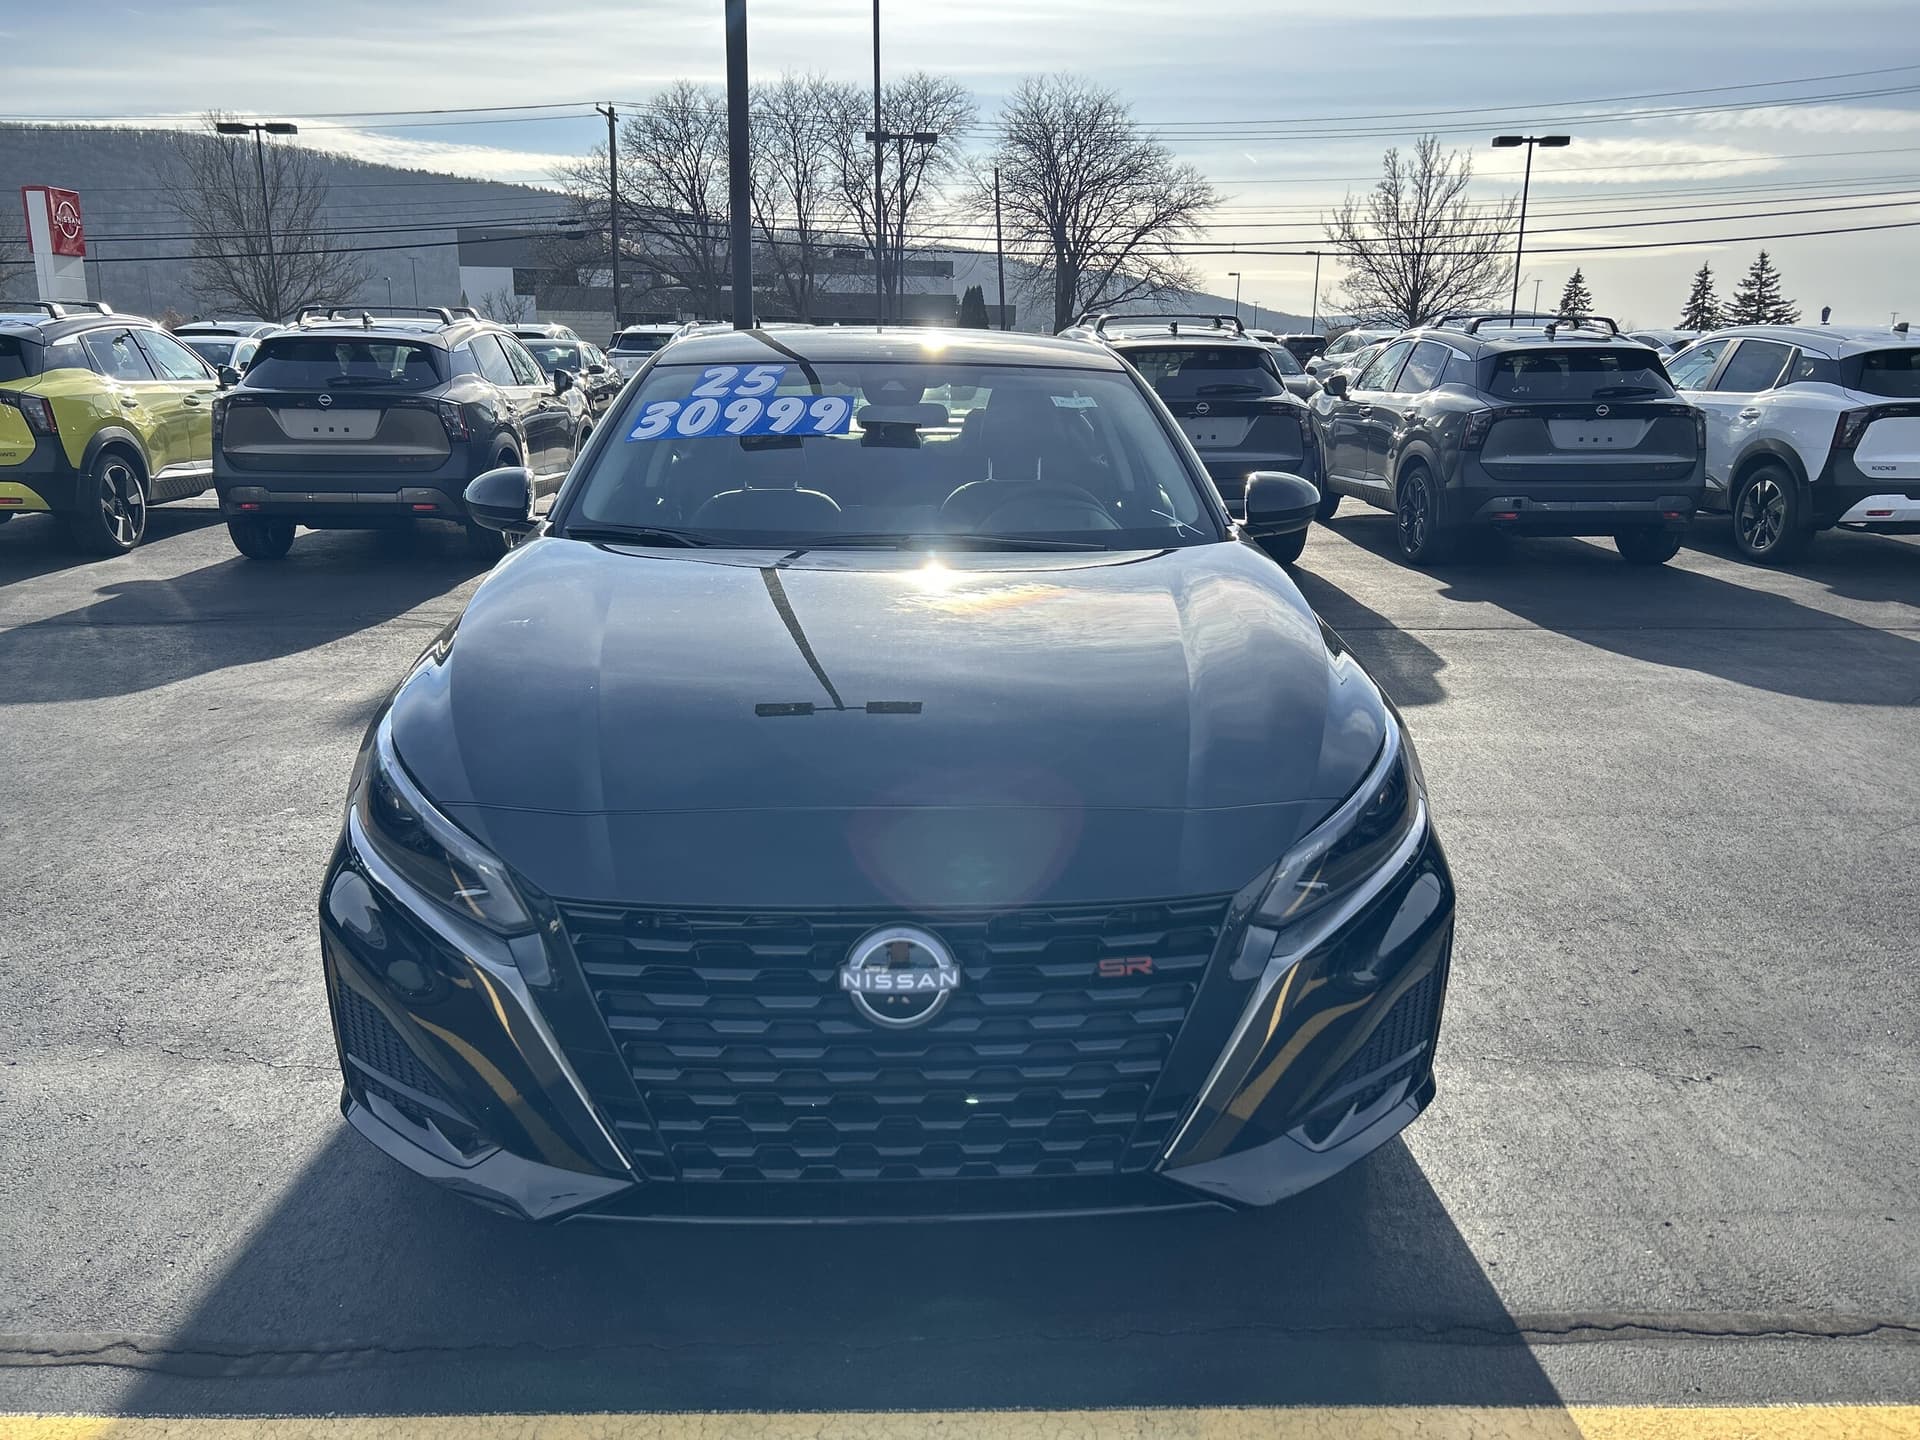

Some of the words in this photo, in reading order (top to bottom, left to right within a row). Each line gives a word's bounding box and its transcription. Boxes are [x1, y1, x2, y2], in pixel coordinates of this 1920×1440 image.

[692, 365, 786, 397] 25
[630, 397, 849, 439] 30999
[843, 970, 957, 989] NISSAN
[1099, 956, 1153, 977] SR
